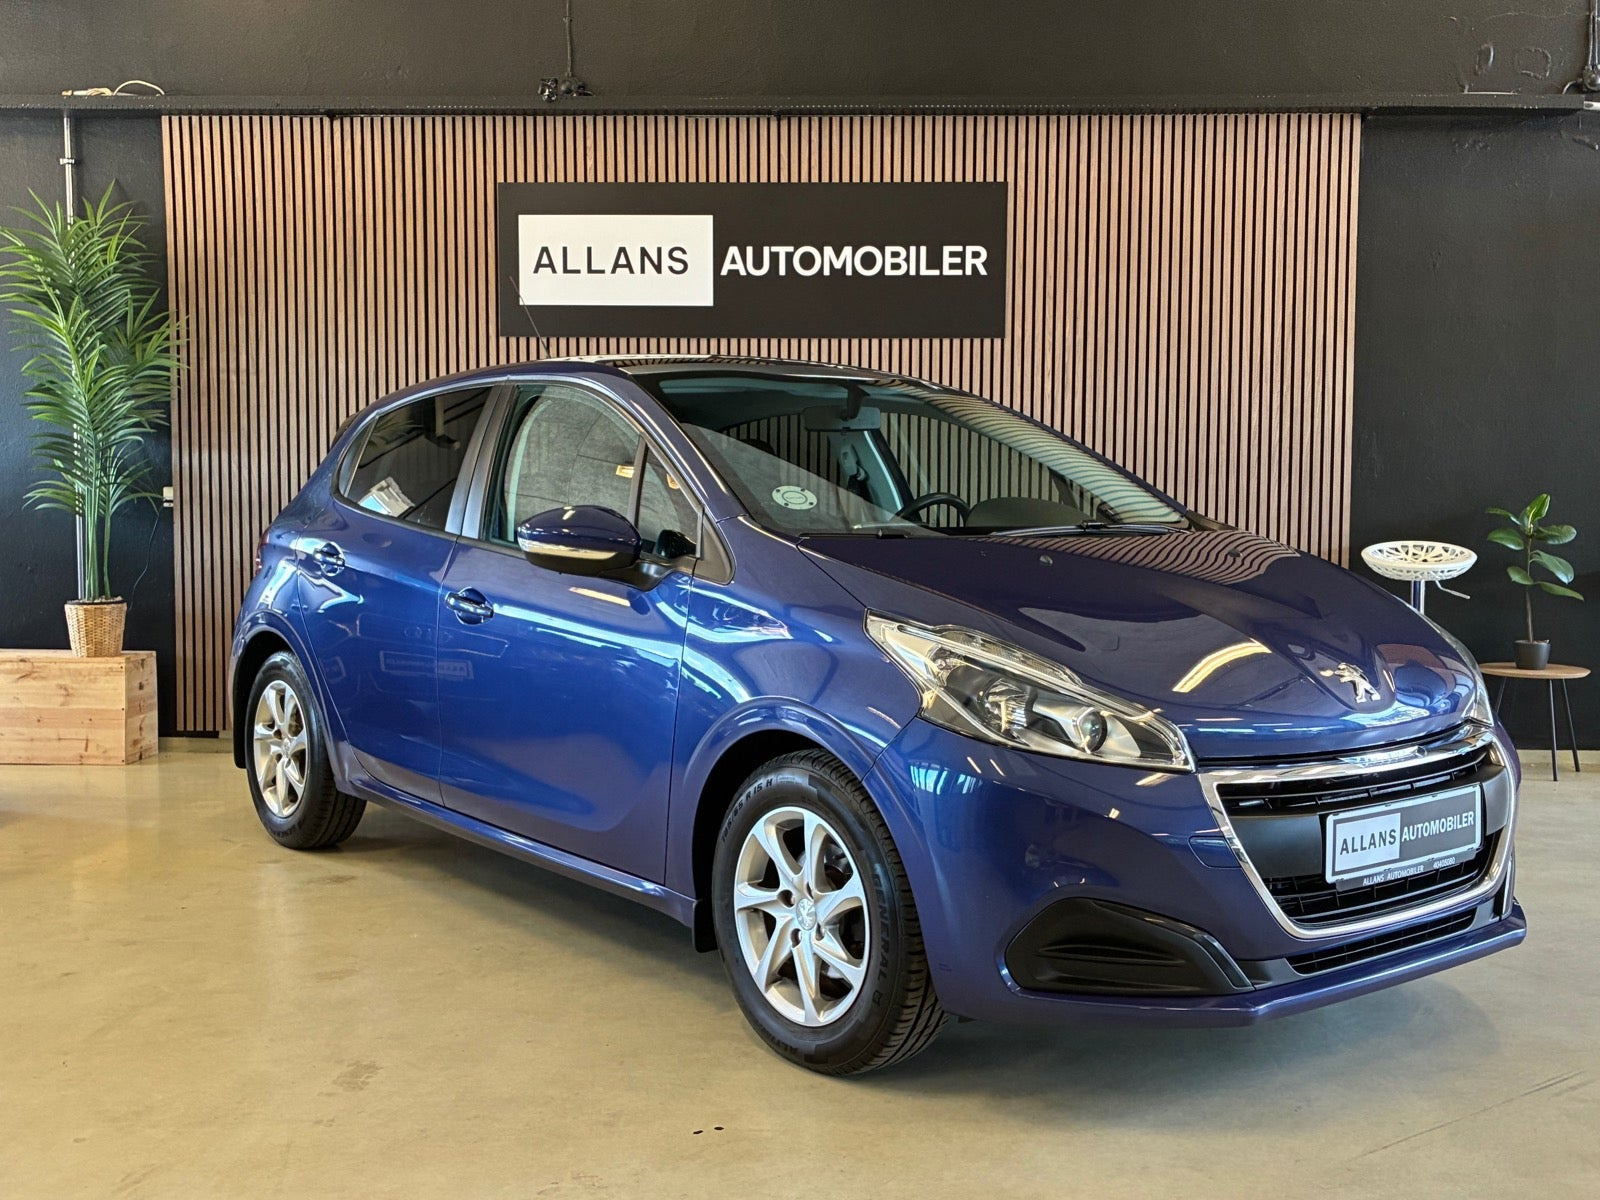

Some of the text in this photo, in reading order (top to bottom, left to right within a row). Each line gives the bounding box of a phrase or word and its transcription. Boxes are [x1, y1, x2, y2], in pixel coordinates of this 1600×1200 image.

[533, 245, 988, 276] ALLANS AUTOMOBILER
[1340, 811, 1474, 855] ALLANS AUTOMOBILER
[1363, 875, 1385, 886] ALLANS
[1387, 865, 1424, 880] AUTOMOBILER
